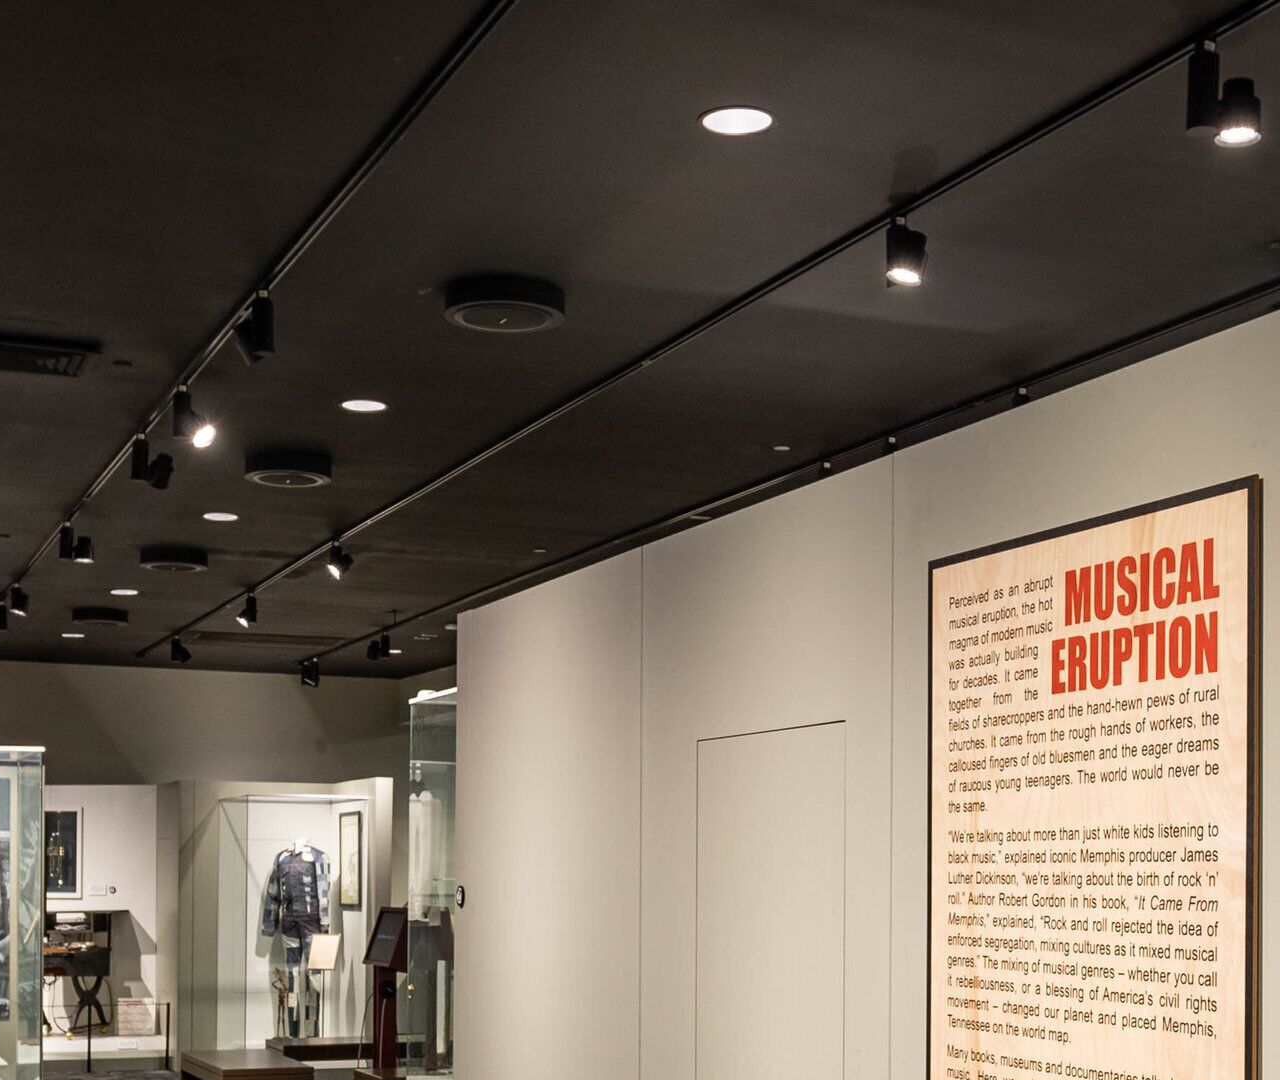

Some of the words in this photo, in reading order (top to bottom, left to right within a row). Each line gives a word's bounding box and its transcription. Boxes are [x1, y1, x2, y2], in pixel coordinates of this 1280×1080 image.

[949, 587, 989, 610] Perceived
[993, 587, 1003, 600] as
[1008, 583, 1019, 597] an
[1024, 573, 1053, 593] abrupt
[1065, 538, 1219, 626] MUSICAL
[948, 610, 979, 630] musical
[981, 605, 1018, 624] eruption,
[1021, 599, 1035, 615] the
[1038, 595, 1053, 612] hot
[948, 634, 979, 651] magma
[980, 629, 989, 644] of
[990, 625, 1023, 642] modern
[1025, 618, 1053, 636] music
[948, 657, 964, 670] was
[968, 649, 1000, 667] actually
[1004, 643, 1038, 661] building
[1052, 612, 1217, 694] ERUPTION
[948, 677, 959, 691] for
[962, 671, 1000, 689] decades.
[1004, 668, 1010, 682] It
[1013, 666, 1038, 681] came
[948, 694, 981, 713] together
[993, 691, 1012, 705] from
[1024, 686, 1038, 701] the
[948, 716, 969, 731] fields
[972, 714, 980, 729] of
[982, 709, 1044, 727] sharecroppers
[1047, 703, 1064, 720] and
[1068, 702, 1083, 717] the
[1086, 696, 1142, 715] hand-hewn
[1146, 692, 1175, 711] pews
[1178, 687, 1190, 704] of
[1194, 683, 1219, 702] rural
[948, 736, 987, 752] churches.
[991, 734, 996, 748] It
[999, 733, 1023, 747] came
[1026, 730, 1046, 744] from
[1050, 726, 1065, 741] the
[1068, 722, 1096, 742] rough
[1100, 719, 1131, 736] hands
[1135, 716, 1146, 733] of
[1149, 713, 1196, 731] workers,
[1201, 709, 1219, 726] the
[989, 755, 1017, 771] fingers
[1020, 751, 1029, 766] of
[1032, 750, 1045, 765] old
[1049, 748, 1095, 763] bluesmen
[1098, 743, 1117, 759] and
[1121, 741, 1137, 757] the
[1141, 741, 1173, 758] eager
[1176, 736, 1219, 753] dreams
[948, 779, 956, 793] of
[959, 779, 991, 792] raucous
[995, 777, 1021, 793] young
[1025, 773, 1072, 789] teenagers.
[1077, 768, 1095, 784] The
[1100, 765, 1127, 782] world
[1131, 762, 1162, 780] would
[1167, 763, 1199, 778] never
[1204, 759, 1219, 775] be
[948, 799, 960, 813] the
[963, 800, 987, 812] same.
[947, 932, 982, 947] enforced
[984, 935, 1037, 952] segregation,
[1040, 937, 1069, 956] mixing
[1072, 938, 1111, 955] cultures
[1113, 943, 1126, 956] as
[1129, 941, 1135, 956] it
[1138, 942, 1170, 959] mixed
[1174, 944, 1217, 962] musical
[947, 1013, 990, 1032] Tennessee
[992, 1022, 1002, 1034] on
[1005, 1021, 1019, 1036] the
[1022, 1024, 1045, 1039] world
[1048, 1029, 1070, 1046] map.
[947, 1043, 968, 1063] Many
[970, 1047, 997, 1066] books,
[1000, 1054, 1042, 1072] museums
[1044, 1059, 1062, 1075] and
